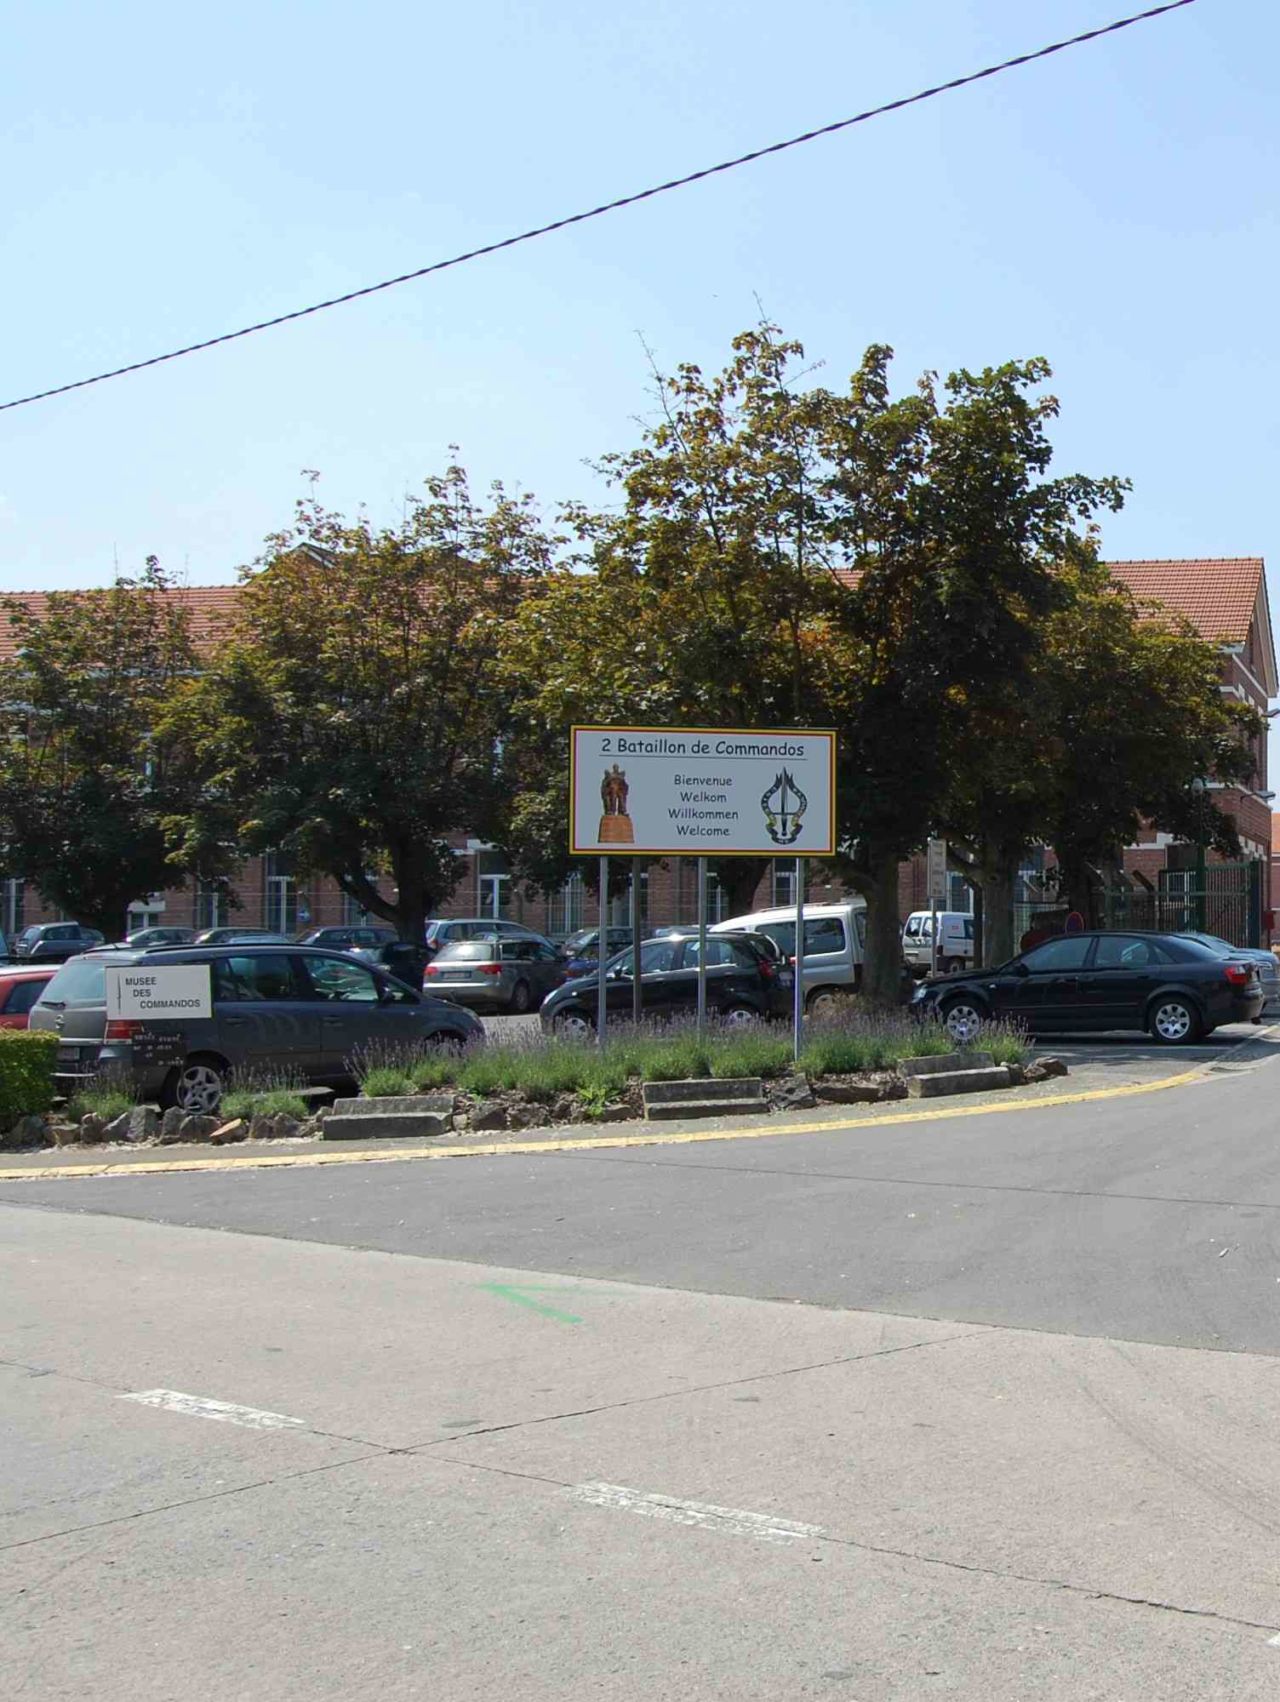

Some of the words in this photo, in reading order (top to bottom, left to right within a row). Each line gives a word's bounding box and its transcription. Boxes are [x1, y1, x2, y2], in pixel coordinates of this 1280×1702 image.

[601, 738, 611, 752] 2
[618, 738, 686, 754] Bataillon
[691, 740, 710, 754] de
[715, 741, 804, 756] Commandos
[674, 774, 733, 786] Bienvenue
[680, 791, 727, 803] Welkom
[668, 808, 739, 820] Willkommen
[676, 825, 730, 836] Welcome
[125, 977, 157, 986] MUSEE
[133, 989, 151, 998] DES
[140, 999, 200, 1009] COMMANDOS
